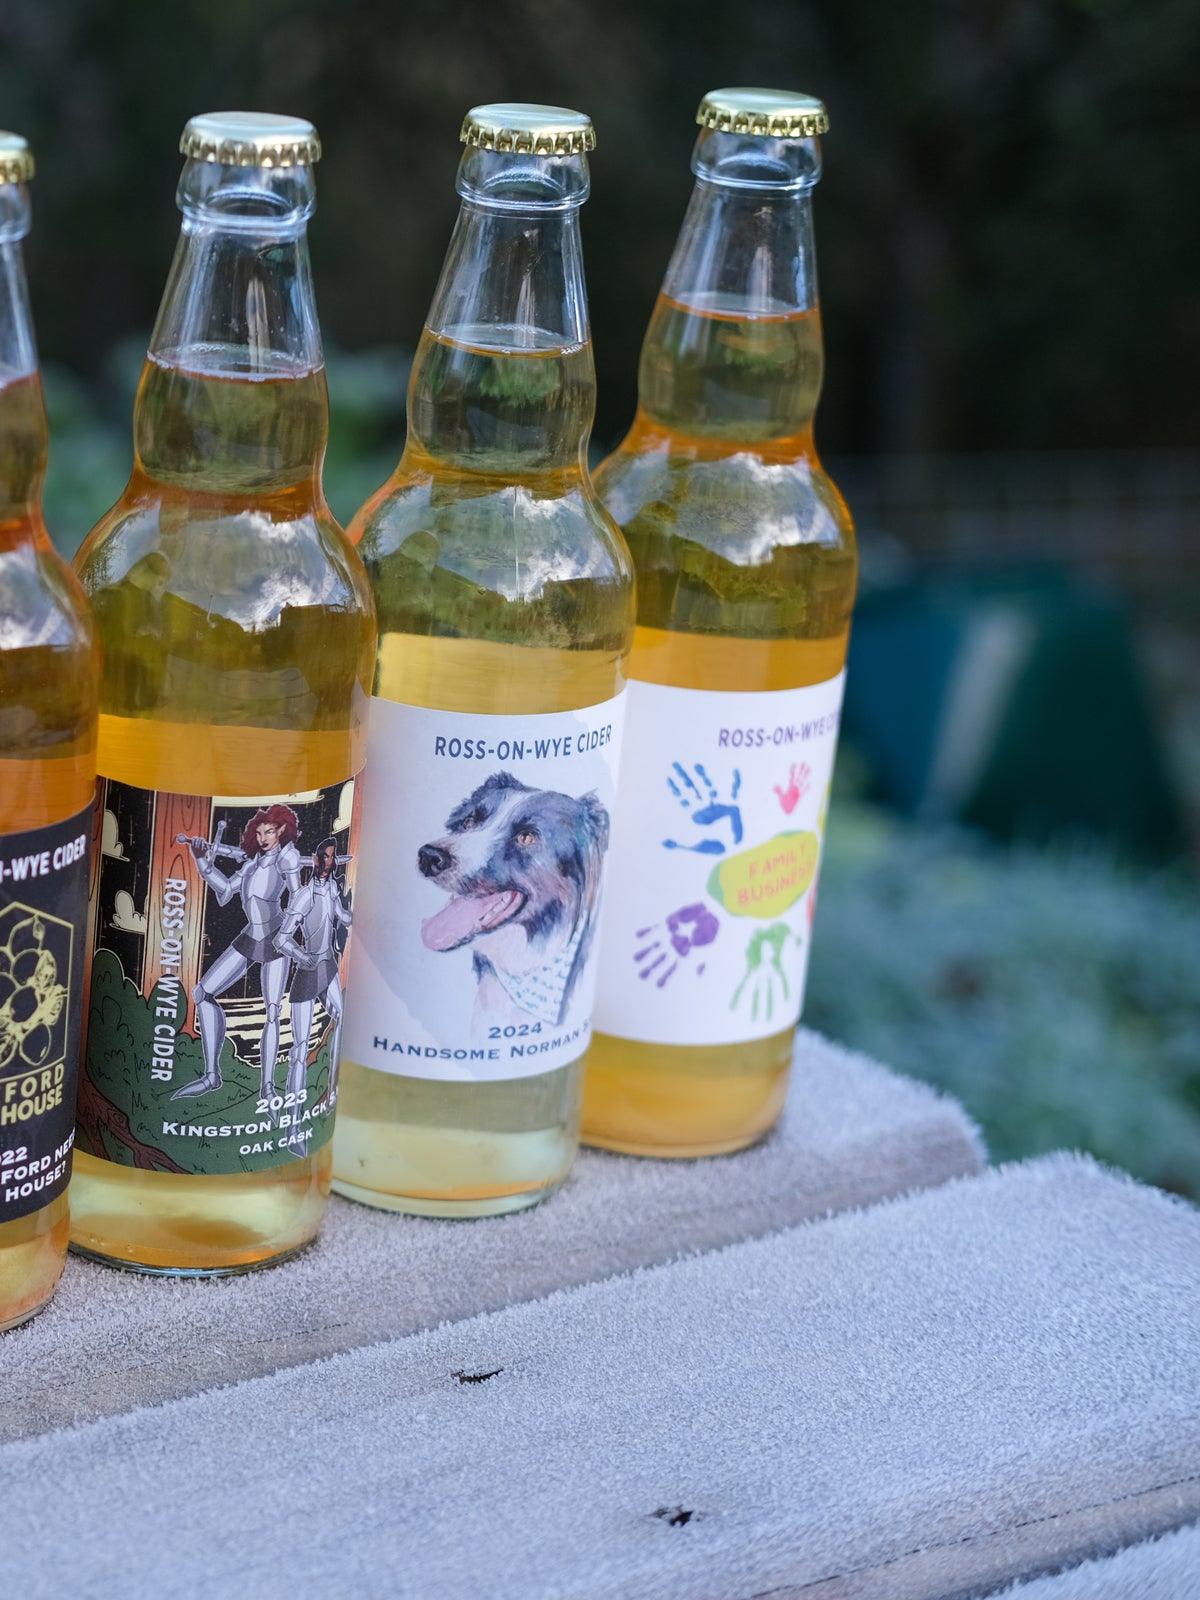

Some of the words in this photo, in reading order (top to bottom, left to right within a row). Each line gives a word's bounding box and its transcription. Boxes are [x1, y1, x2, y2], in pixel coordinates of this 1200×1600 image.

[434, 736, 572, 760] ROSS-ON-WYE
[577, 724, 612, 752] CIDER
[52, 834, 87, 871] CIDER
[155, 878, 188, 1019] ROSS-ON-WYE
[488, 1022, 543, 1039] 2024
[150, 1024, 177, 1081] CIDER
[0, 1083, 63, 1126] HOUSE
[162, 1120, 272, 1137] KINGSTON
[278, 1101, 328, 1129] BLACK
[254, 1088, 308, 1114] 2023
[239, 1140, 274, 1155] OAK
[277, 1128, 314, 1148] CASK
[5, 1160, 66, 1202] HOUSE?
